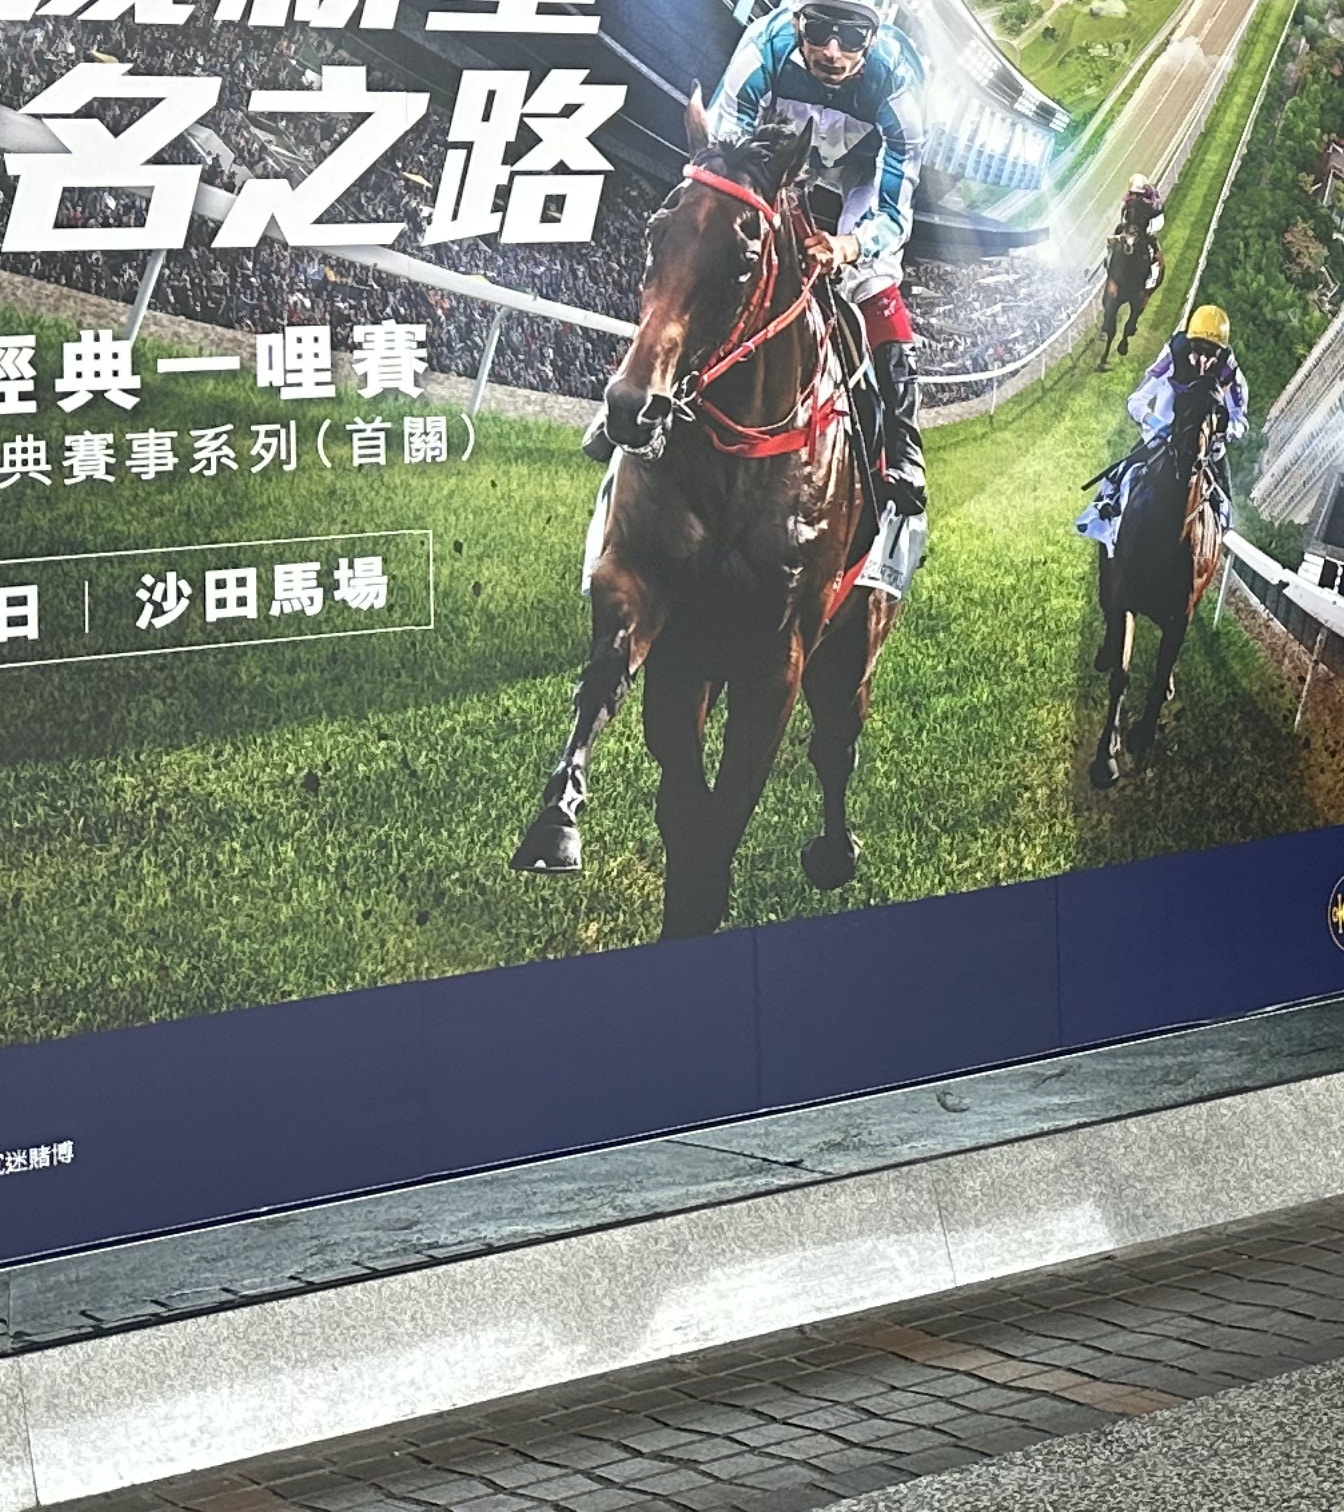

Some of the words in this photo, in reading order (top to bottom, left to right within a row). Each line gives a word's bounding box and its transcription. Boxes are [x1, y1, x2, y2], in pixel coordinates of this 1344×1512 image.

[3, 61, 628, 253] 名之路
[0, 584, 40, 642] 日
[135, 555, 389, 631] 沙田馬場
[0, 1140, 75, 1176] 迷賭博
